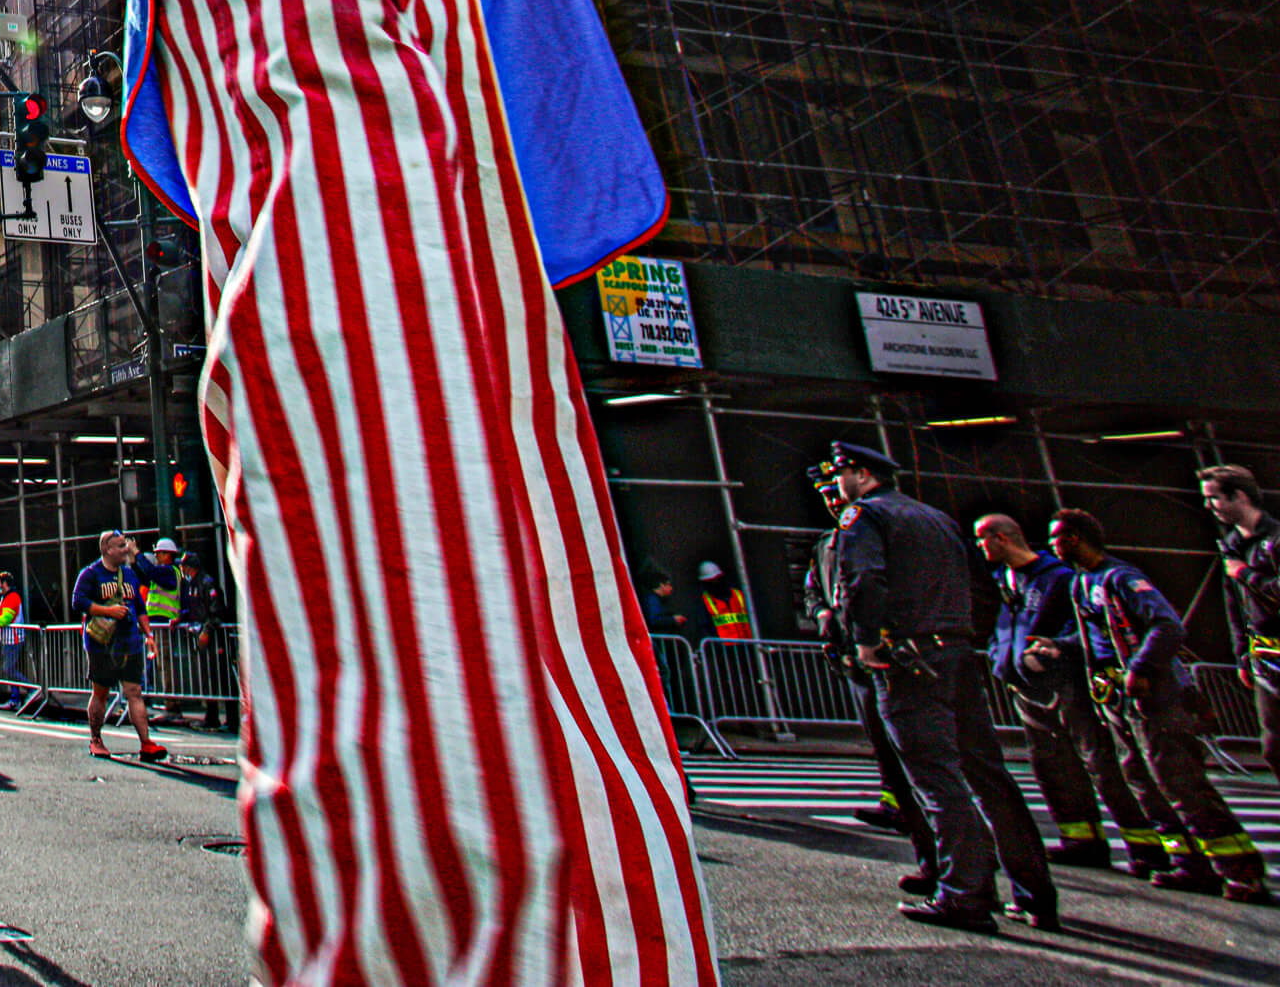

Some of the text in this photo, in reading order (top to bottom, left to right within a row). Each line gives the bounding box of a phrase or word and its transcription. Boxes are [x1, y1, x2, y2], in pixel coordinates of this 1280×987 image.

[46, 157, 69, 169] ANES
[60, 214, 83, 226] BUSES
[18, 223, 37, 234] ONLY
[63, 227, 82, 238] ONLY
[601, 261, 681, 284] SPRING
[876, 296, 899, 318] 424
[918, 301, 968, 324] AVENUE
[111, 365, 140, 384] Fifth Ave
